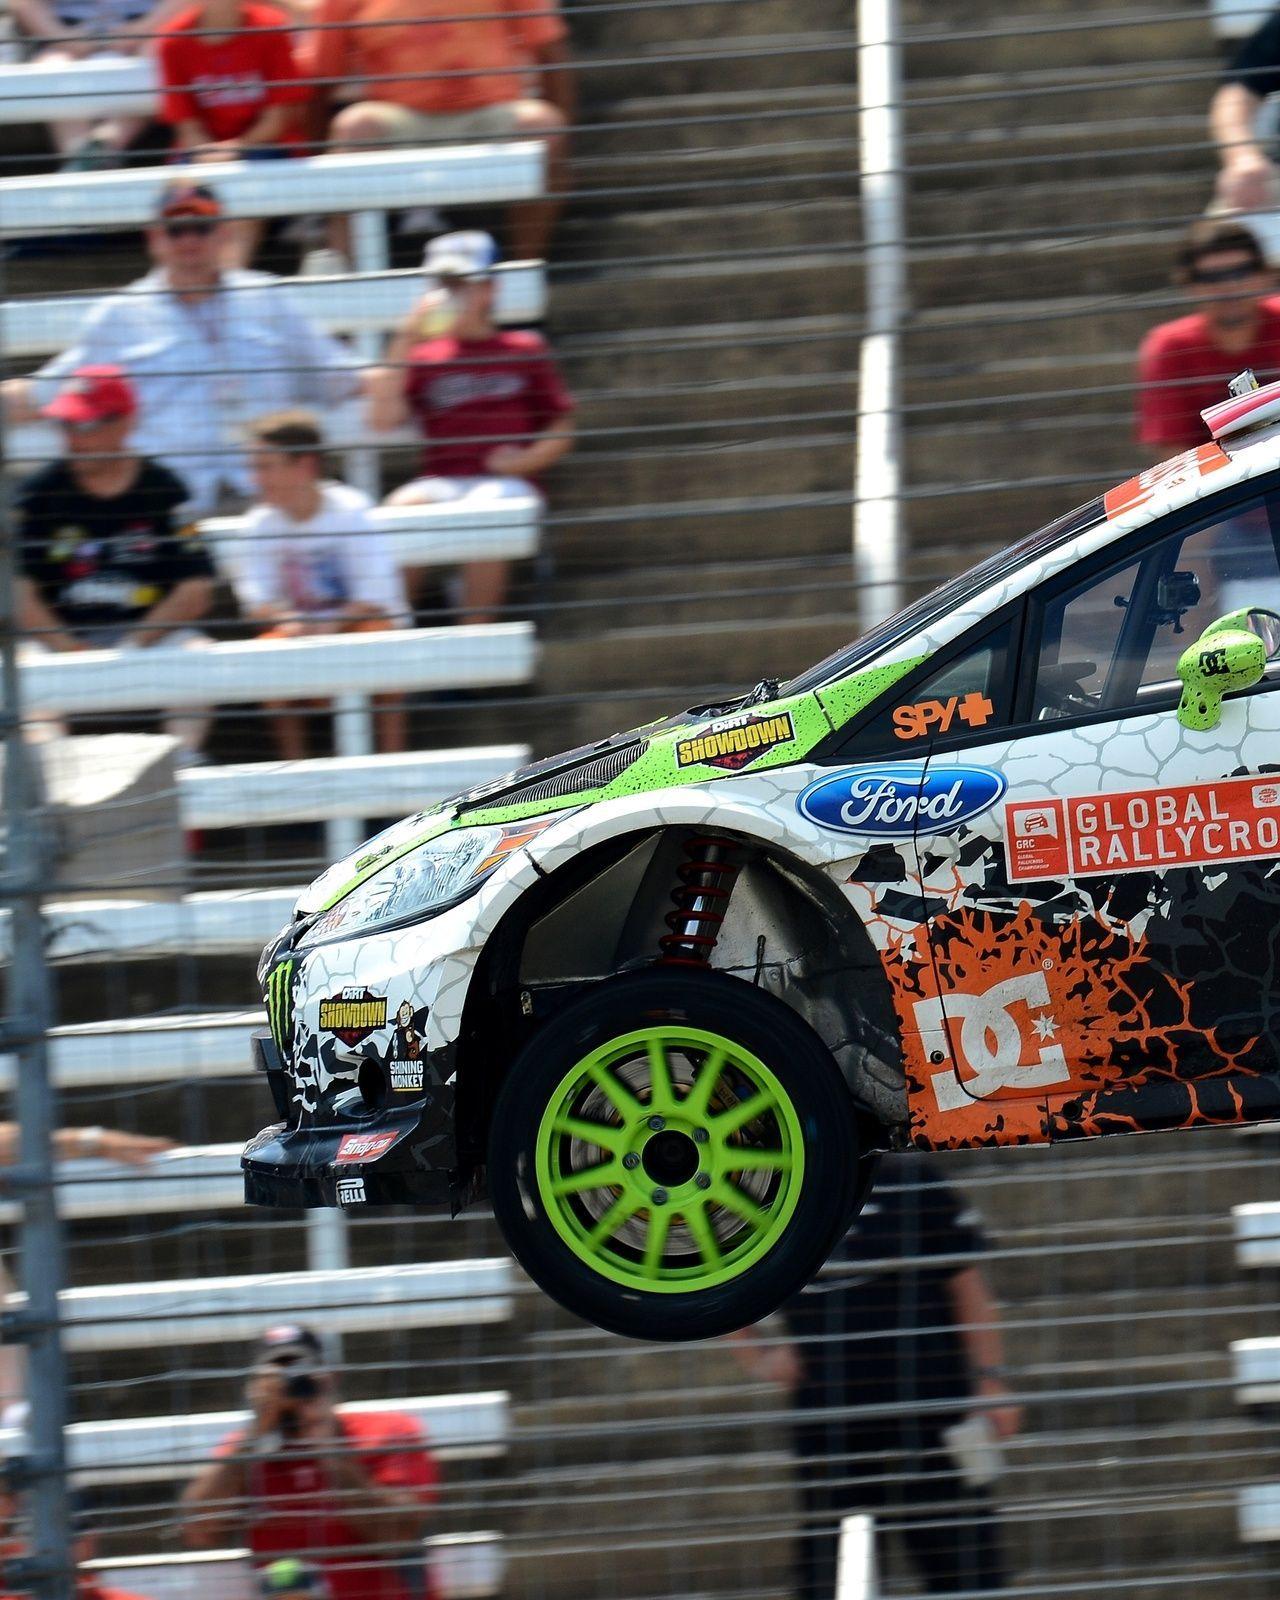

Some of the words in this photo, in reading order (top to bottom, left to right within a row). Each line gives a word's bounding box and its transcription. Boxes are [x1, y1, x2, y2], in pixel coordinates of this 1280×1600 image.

[1198, 648, 1231, 677] DC
[678, 716, 792, 764] SHOWDOWN
[840, 774, 964, 825] Ford
[1075, 790, 1230, 834] GLOBAL
[1016, 839, 1036, 850] GRC
[320, 1001, 386, 1029] SHOWDOWN
[912, 970, 1071, 1112] DC
[390, 1060, 424, 1075] SHINING
[391, 1074, 424, 1088] MONKEY
